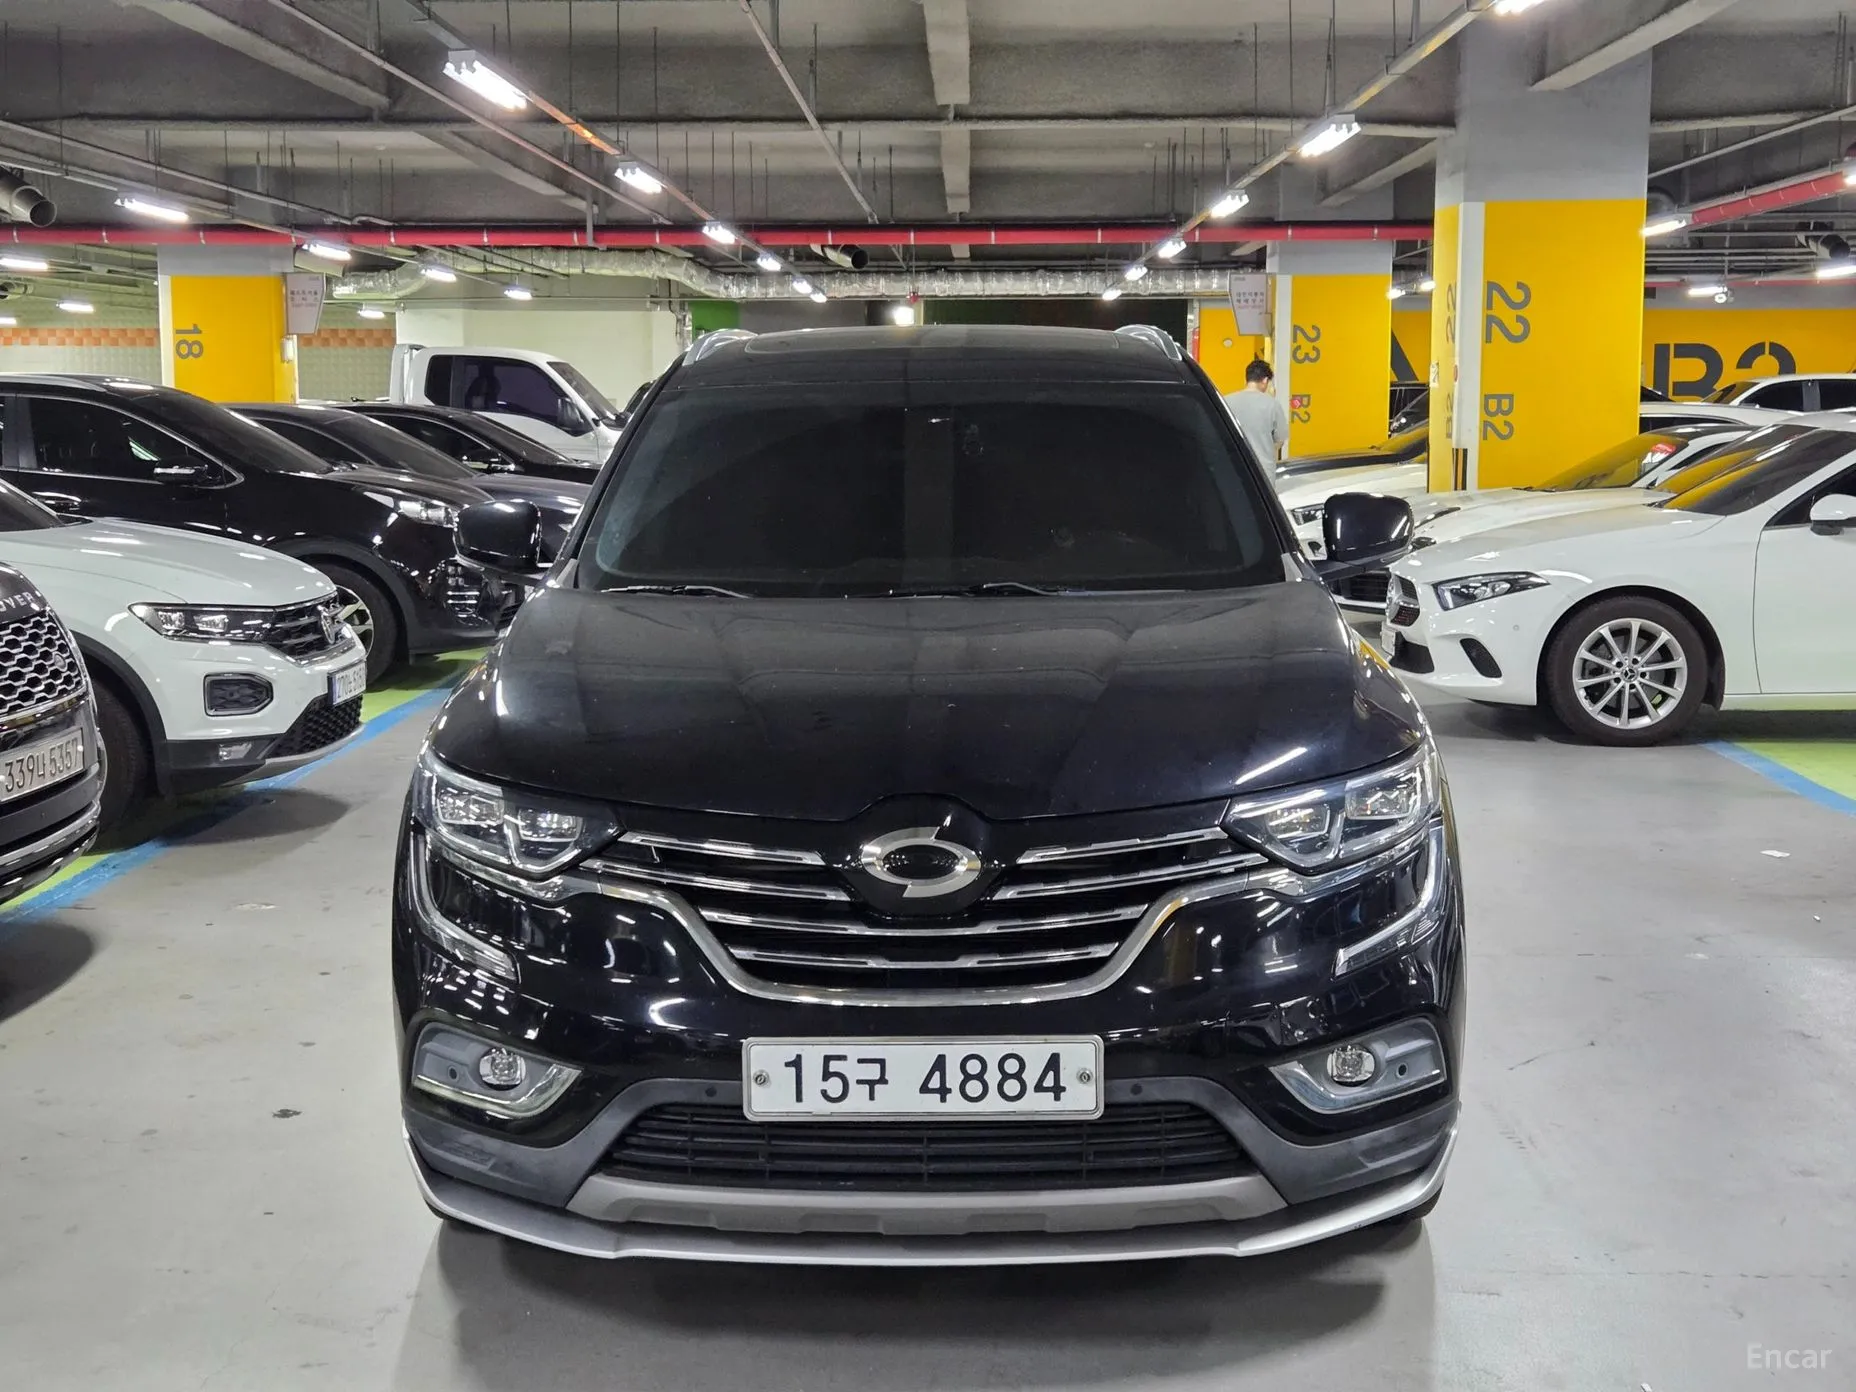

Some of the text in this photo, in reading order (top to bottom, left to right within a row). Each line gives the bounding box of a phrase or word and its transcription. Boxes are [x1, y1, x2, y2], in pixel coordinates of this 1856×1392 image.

[1485, 280, 1532, 344] 22
[175, 323, 204, 360] 18
[1292, 325, 1321, 364] 23
[1291, 394, 1312, 424] B2
[1482, 393, 1515, 441] B2
[5, 737, 78, 793] 339나 5357
[784, 1052, 1067, 1103] 15구 4884
